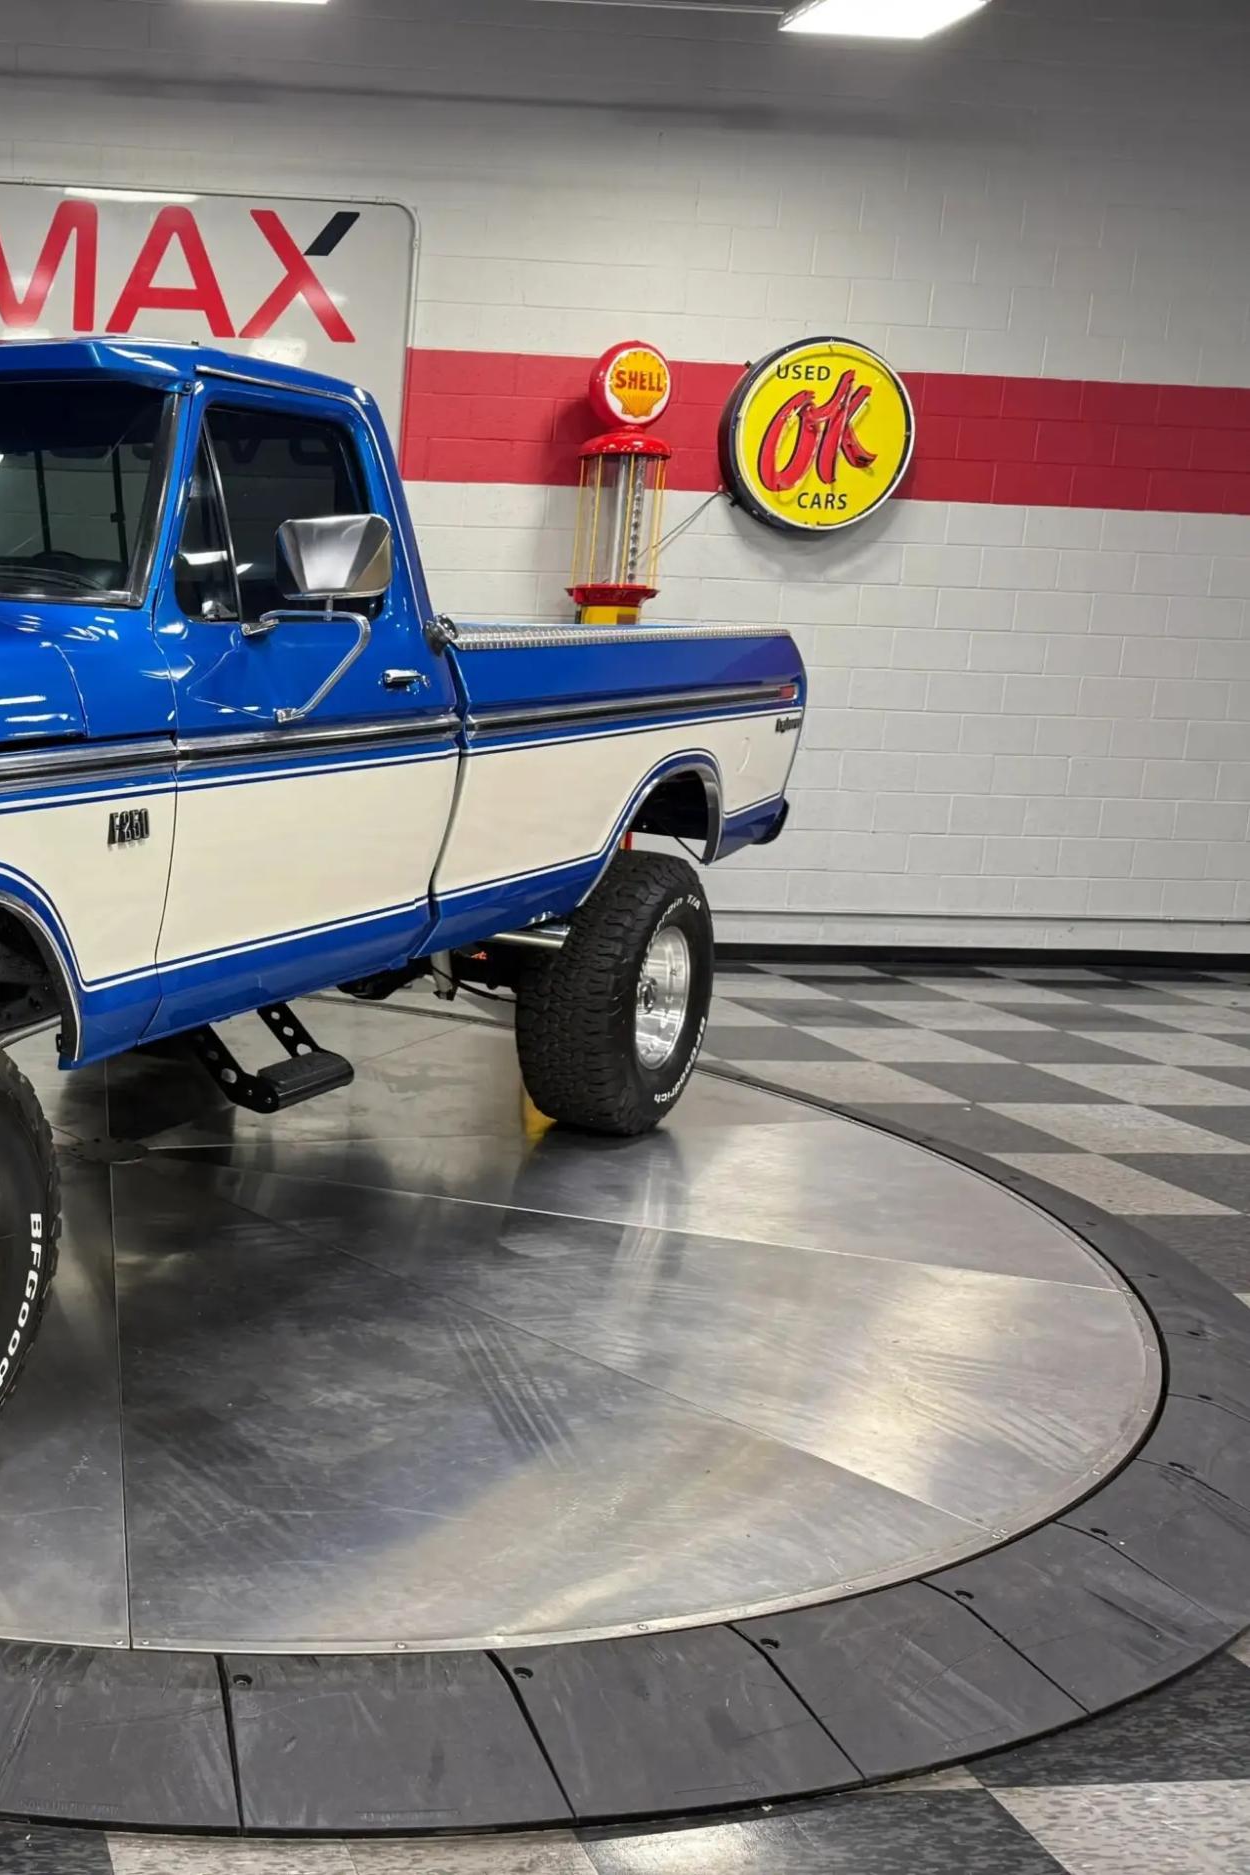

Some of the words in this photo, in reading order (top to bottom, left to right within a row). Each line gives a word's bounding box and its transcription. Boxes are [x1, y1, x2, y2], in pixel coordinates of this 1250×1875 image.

[614, 369, 665, 393] SHELL
[776, 363, 831, 381] USED
[797, 492, 847, 510] CARS
